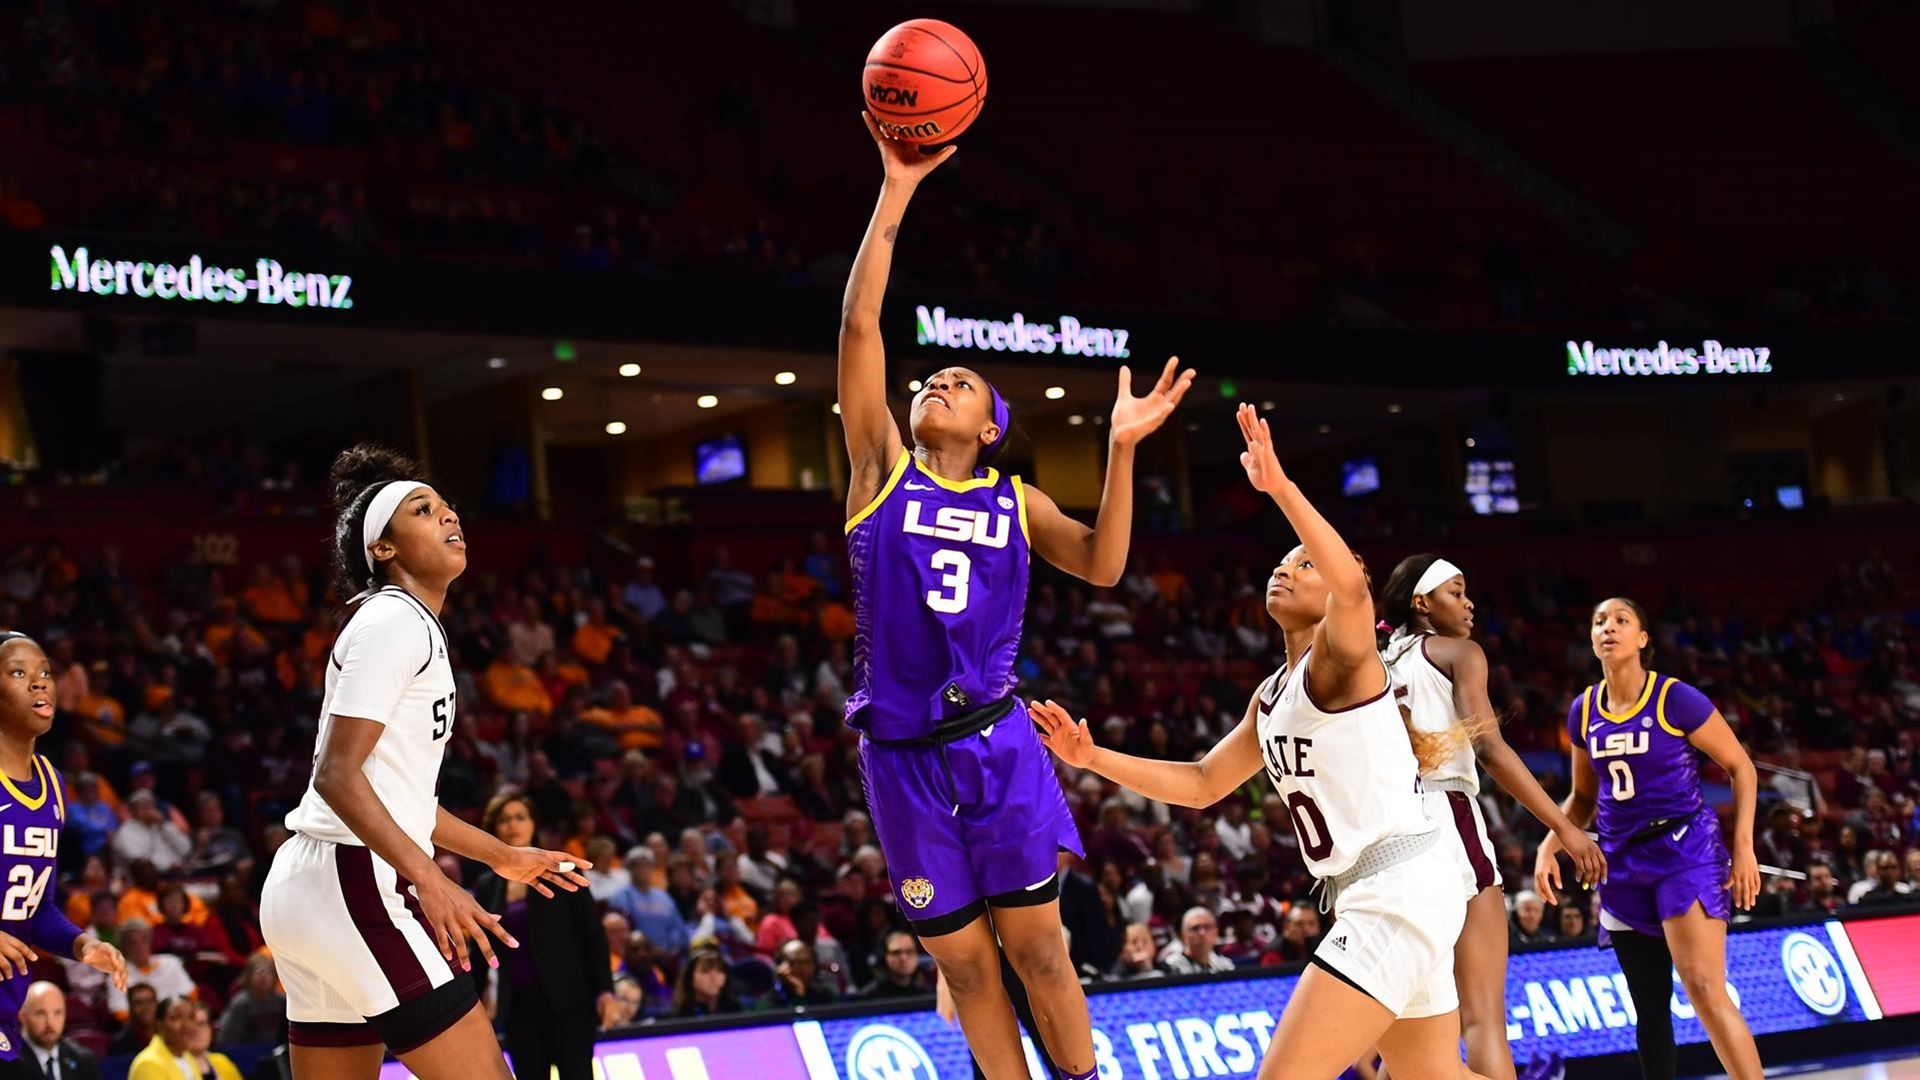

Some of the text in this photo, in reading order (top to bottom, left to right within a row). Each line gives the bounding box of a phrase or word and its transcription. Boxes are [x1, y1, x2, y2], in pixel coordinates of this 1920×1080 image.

[869, 83, 918, 107] NCAA
[50, 245, 353, 309] Mercedes-Benz
[916, 305, 1130, 358] Mercedes-Benz
[1567, 340, 1772, 376] Mercedes-Benz
[903, 500, 1011, 549] LSU
[926, 548, 971, 614] 3
[1261, 735, 1315, 783] ATE
[1590, 731, 1650, 759] LSU
[1608, 760, 1635, 801] 0
[3, 824, 58, 858] LSU
[1, 864, 52, 921] 24
[1125, 1011, 1277, 1080] FIRST
